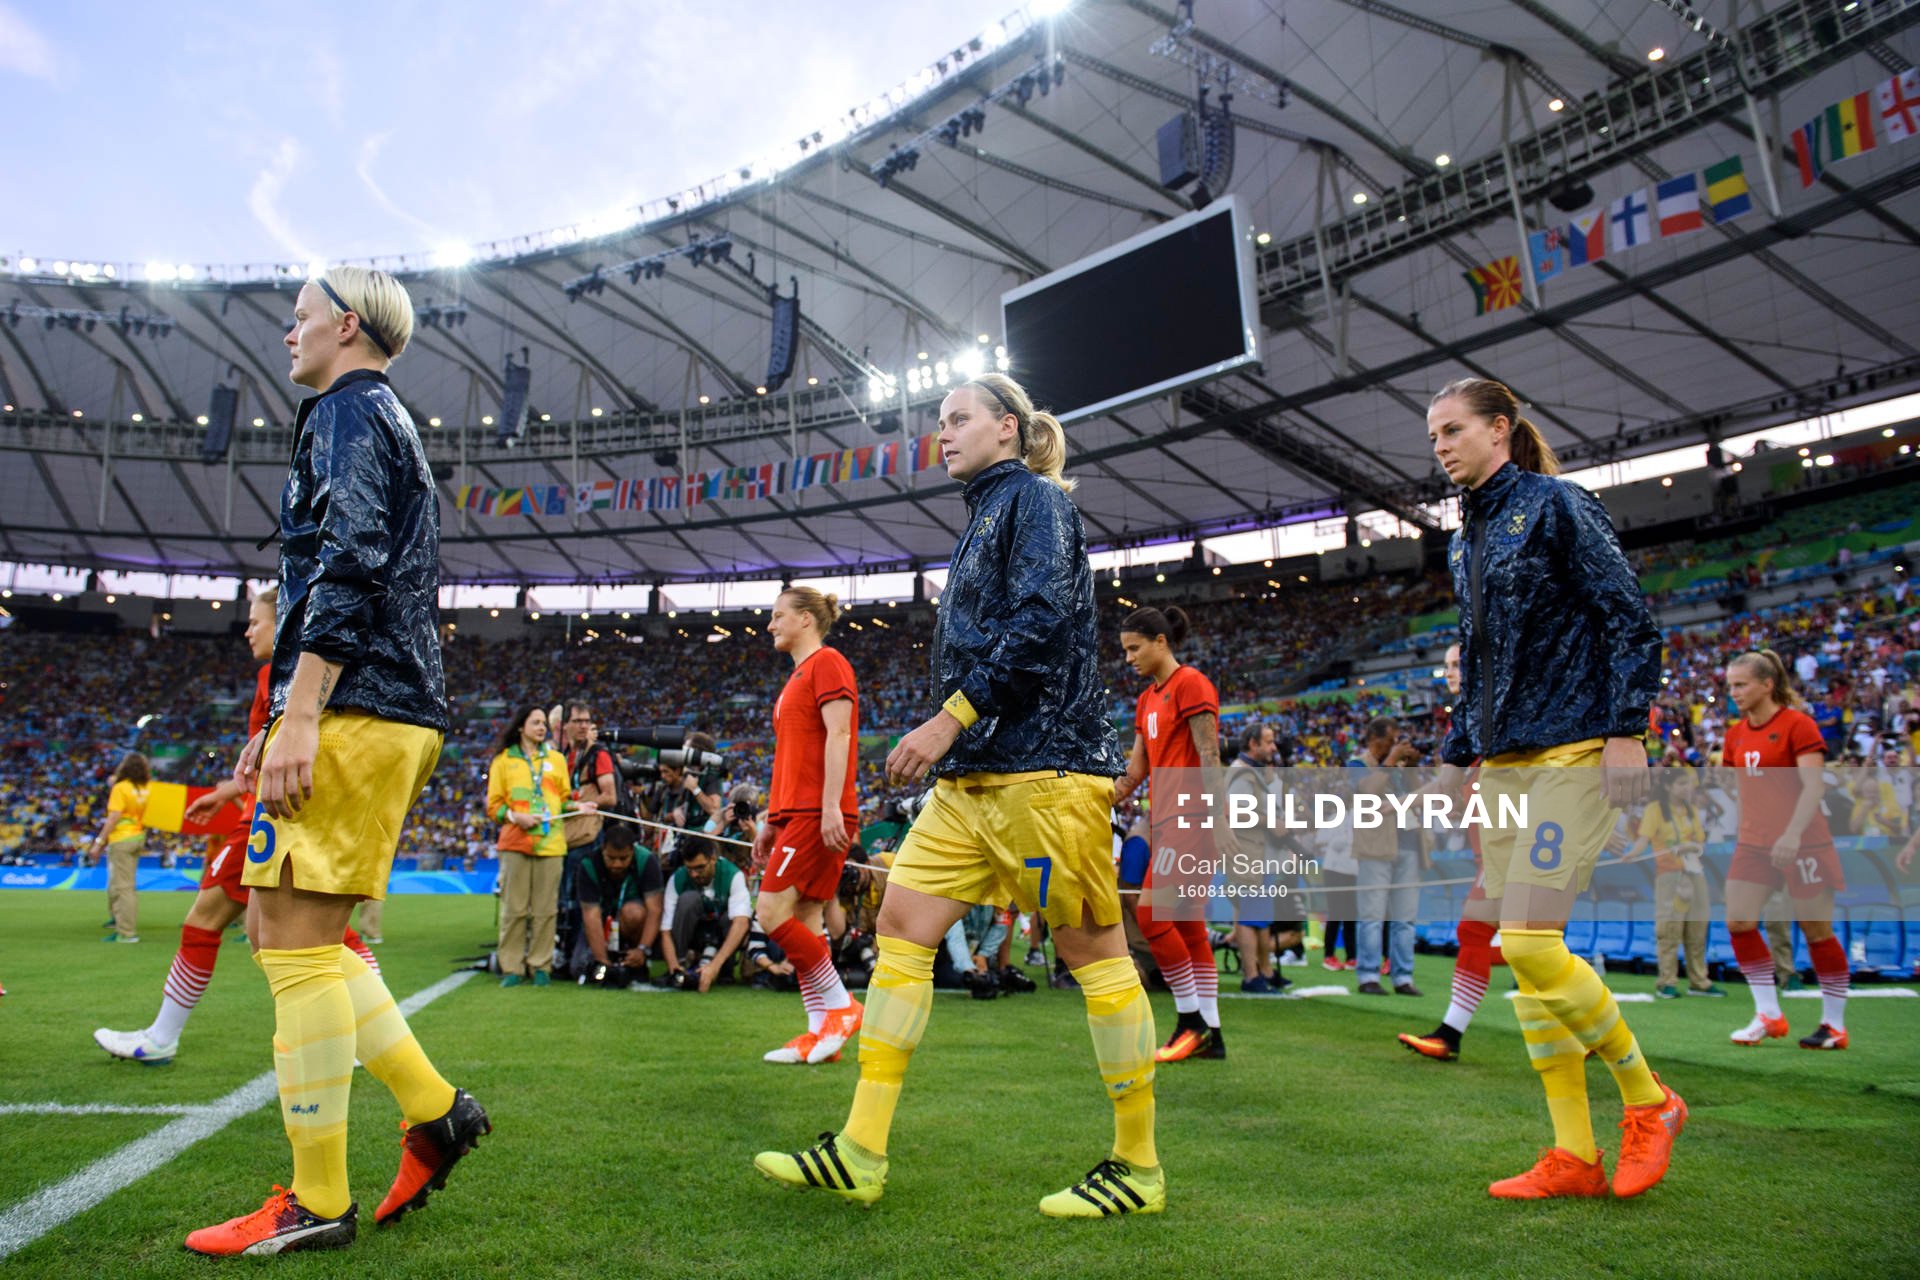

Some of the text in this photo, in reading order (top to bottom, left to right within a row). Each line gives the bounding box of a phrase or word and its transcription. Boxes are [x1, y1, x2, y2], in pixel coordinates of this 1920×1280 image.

[1147, 712, 1158, 740] 10
[1744, 751, 1764, 777] 12
[247, 802, 276, 864] 5
[1530, 821, 1564, 870] 8
[211, 845, 232, 877] 4
[776, 845, 797, 877] 7
[1152, 846, 1177, 876] 10
[1796, 857, 1823, 885] 12
[1023, 856, 1052, 908] 7
